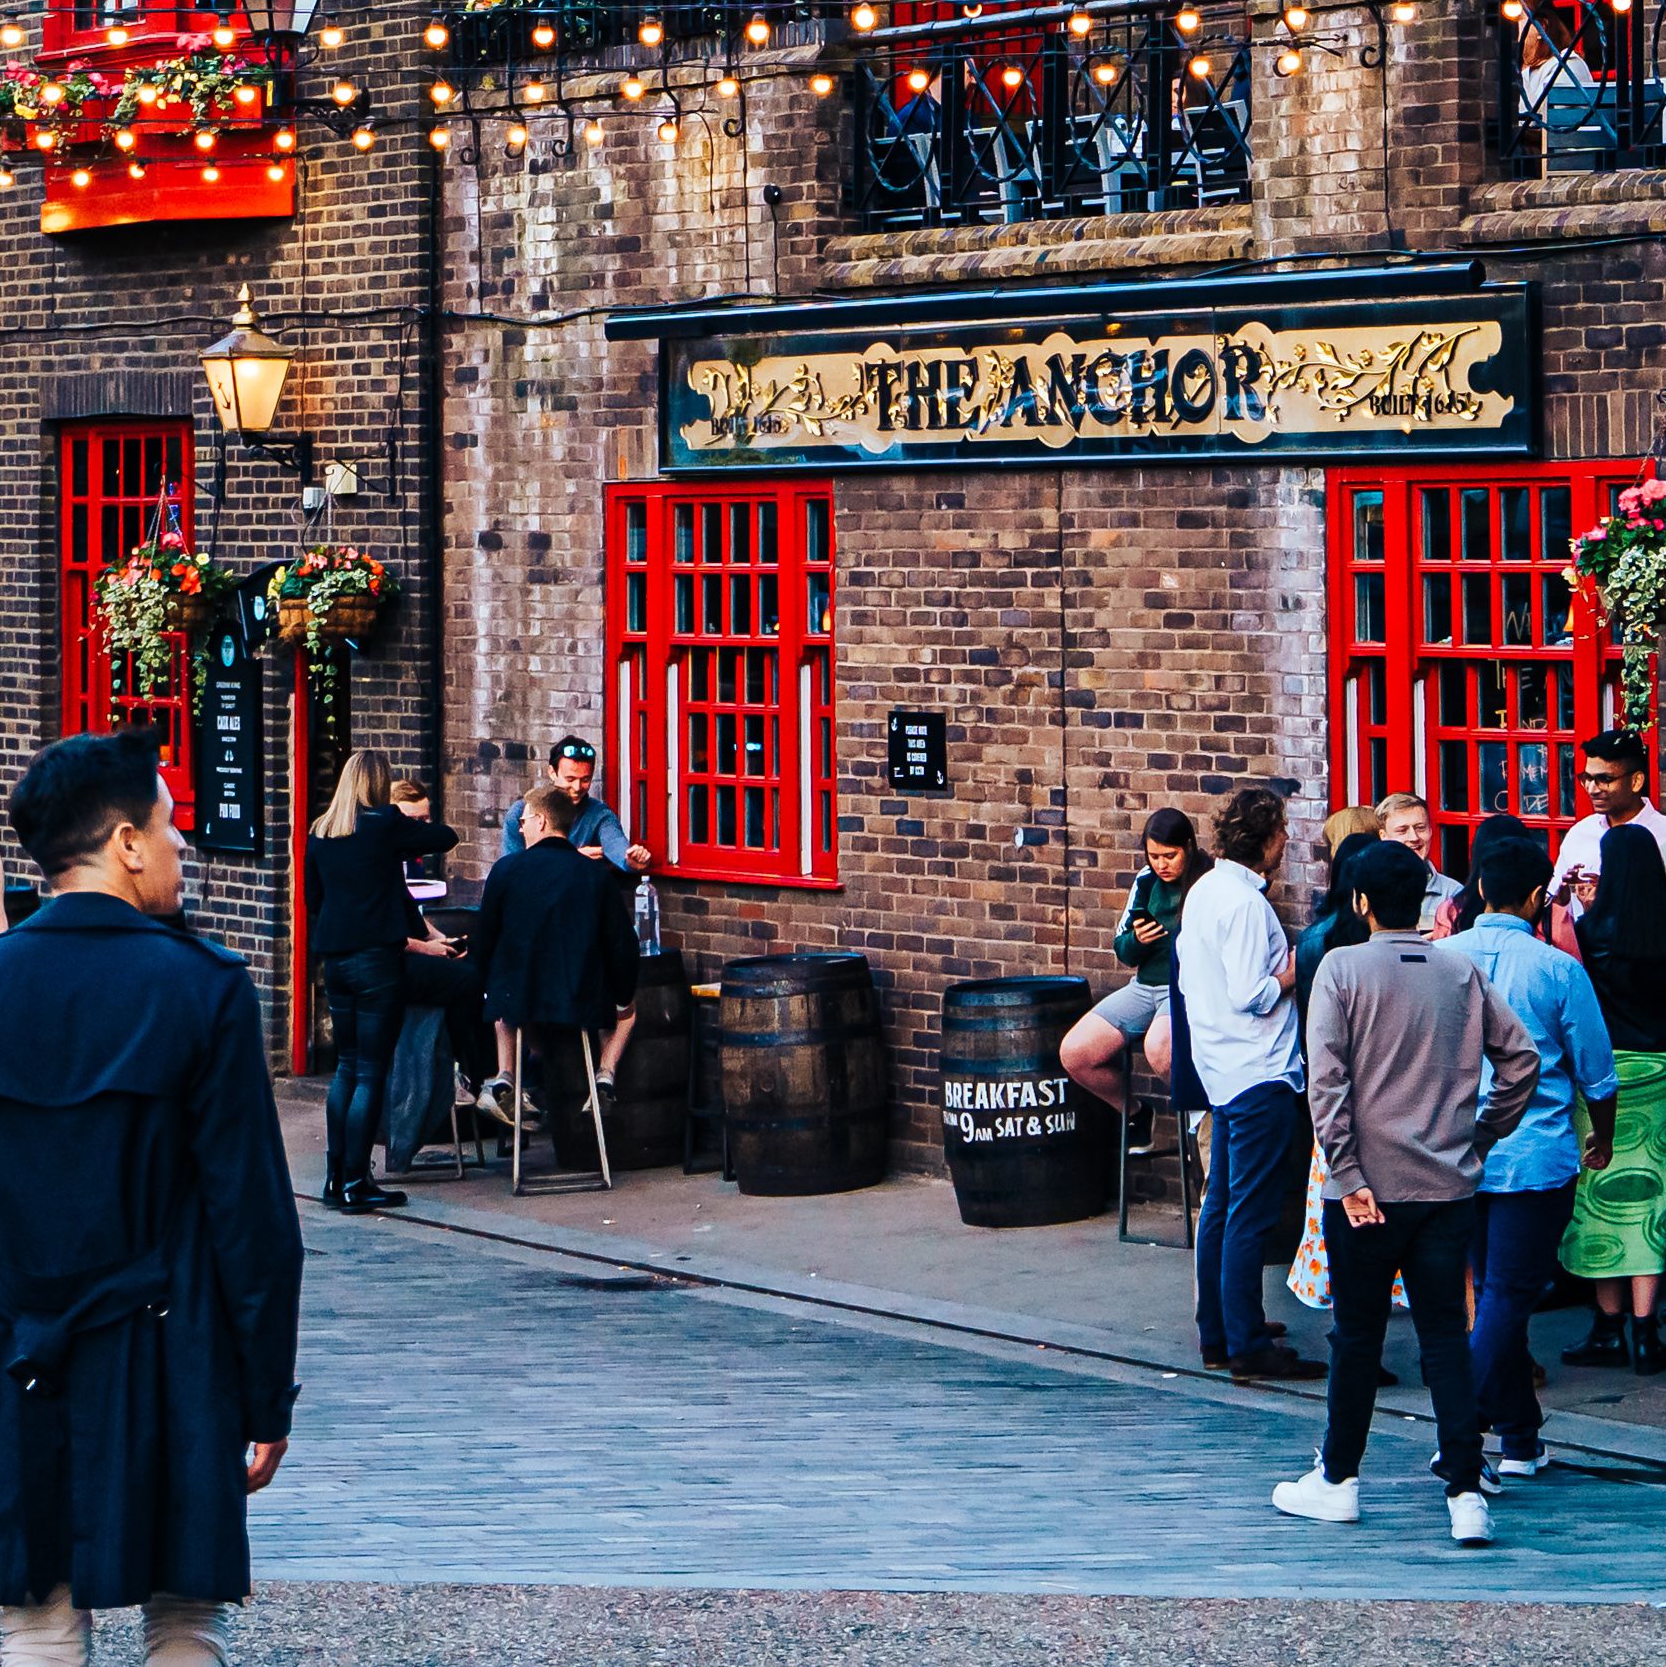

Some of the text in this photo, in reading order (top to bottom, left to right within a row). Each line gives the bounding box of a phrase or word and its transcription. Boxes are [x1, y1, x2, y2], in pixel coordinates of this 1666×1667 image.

[864, 342, 1266, 433] THE ANCHOR
[1369, 393, 1419, 416] BUILT
[944, 1077, 1069, 1110] BREAKFAST
[995, 1116, 1024, 1138] SAT
[1026, 1115, 1042, 1136] &
[1044, 1111, 1076, 1135] SUN
